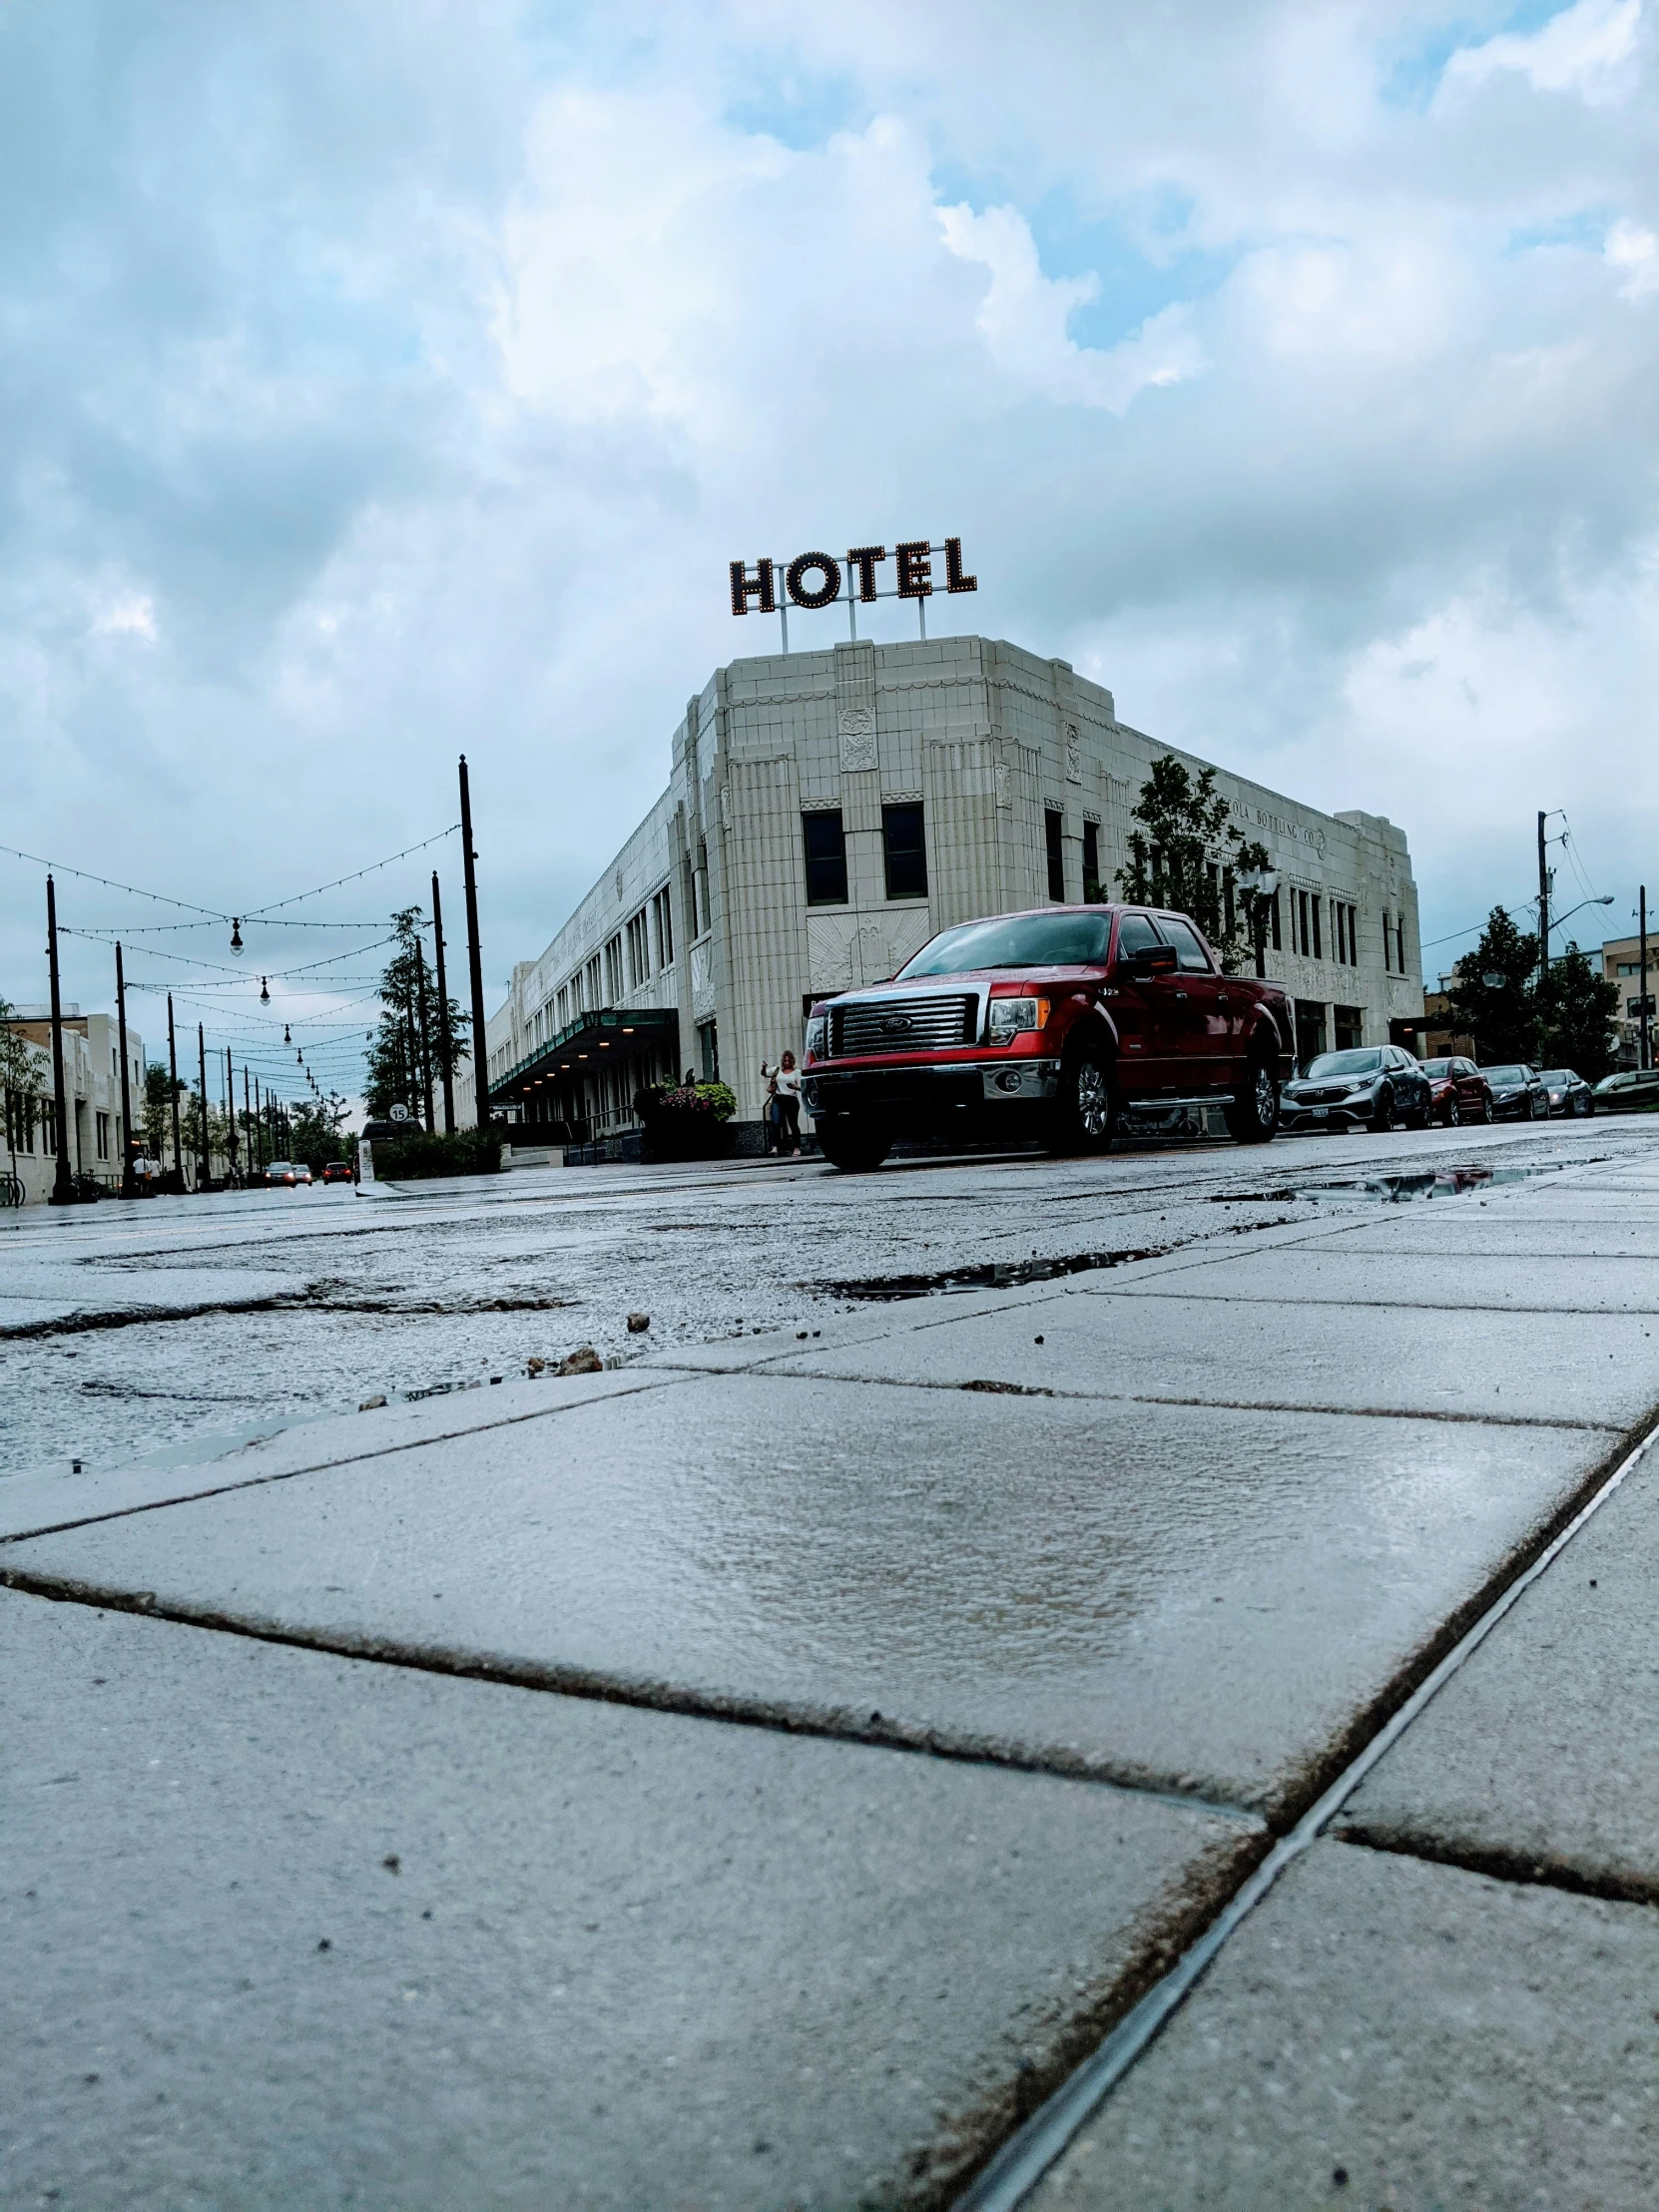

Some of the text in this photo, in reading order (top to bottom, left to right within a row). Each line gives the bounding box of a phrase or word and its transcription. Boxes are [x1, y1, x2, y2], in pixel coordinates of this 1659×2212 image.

[730, 537, 977, 616] HOTEL
[1257, 810, 1298, 838] BOTTLING
[392, 1109, 405, 1120] 15
